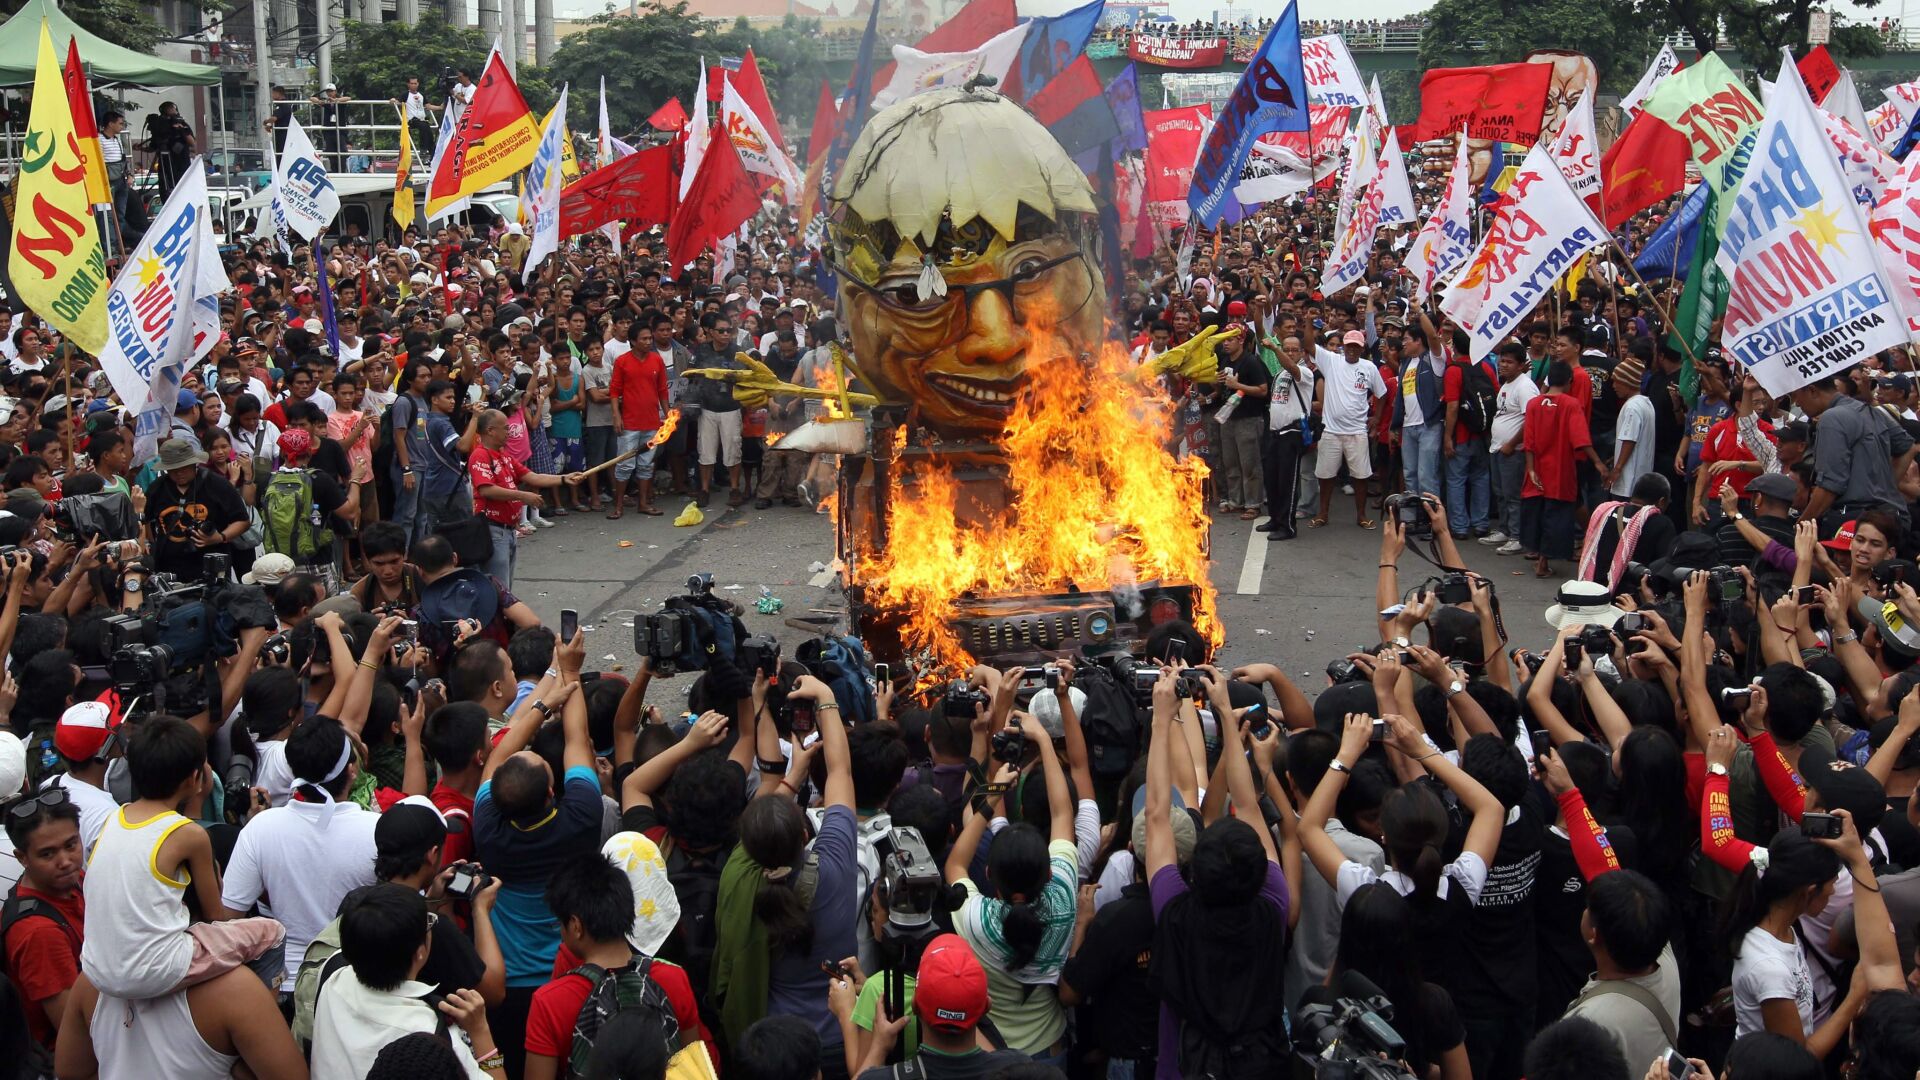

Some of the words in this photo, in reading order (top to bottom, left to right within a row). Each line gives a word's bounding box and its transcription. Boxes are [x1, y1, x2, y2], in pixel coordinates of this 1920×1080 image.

[1165, 38, 1181, 49] ANG
[1185, 38, 1218, 50] TANIKALA
[1138, 44, 1148, 54] NG
[1151, 48, 1196, 60] KAHIRAPAN!
[287, 156, 336, 200] ACT
[308, 201, 319, 210] OF
[295, 201, 328, 225] TEACHERS
[938, 1010, 964, 1020] PING
